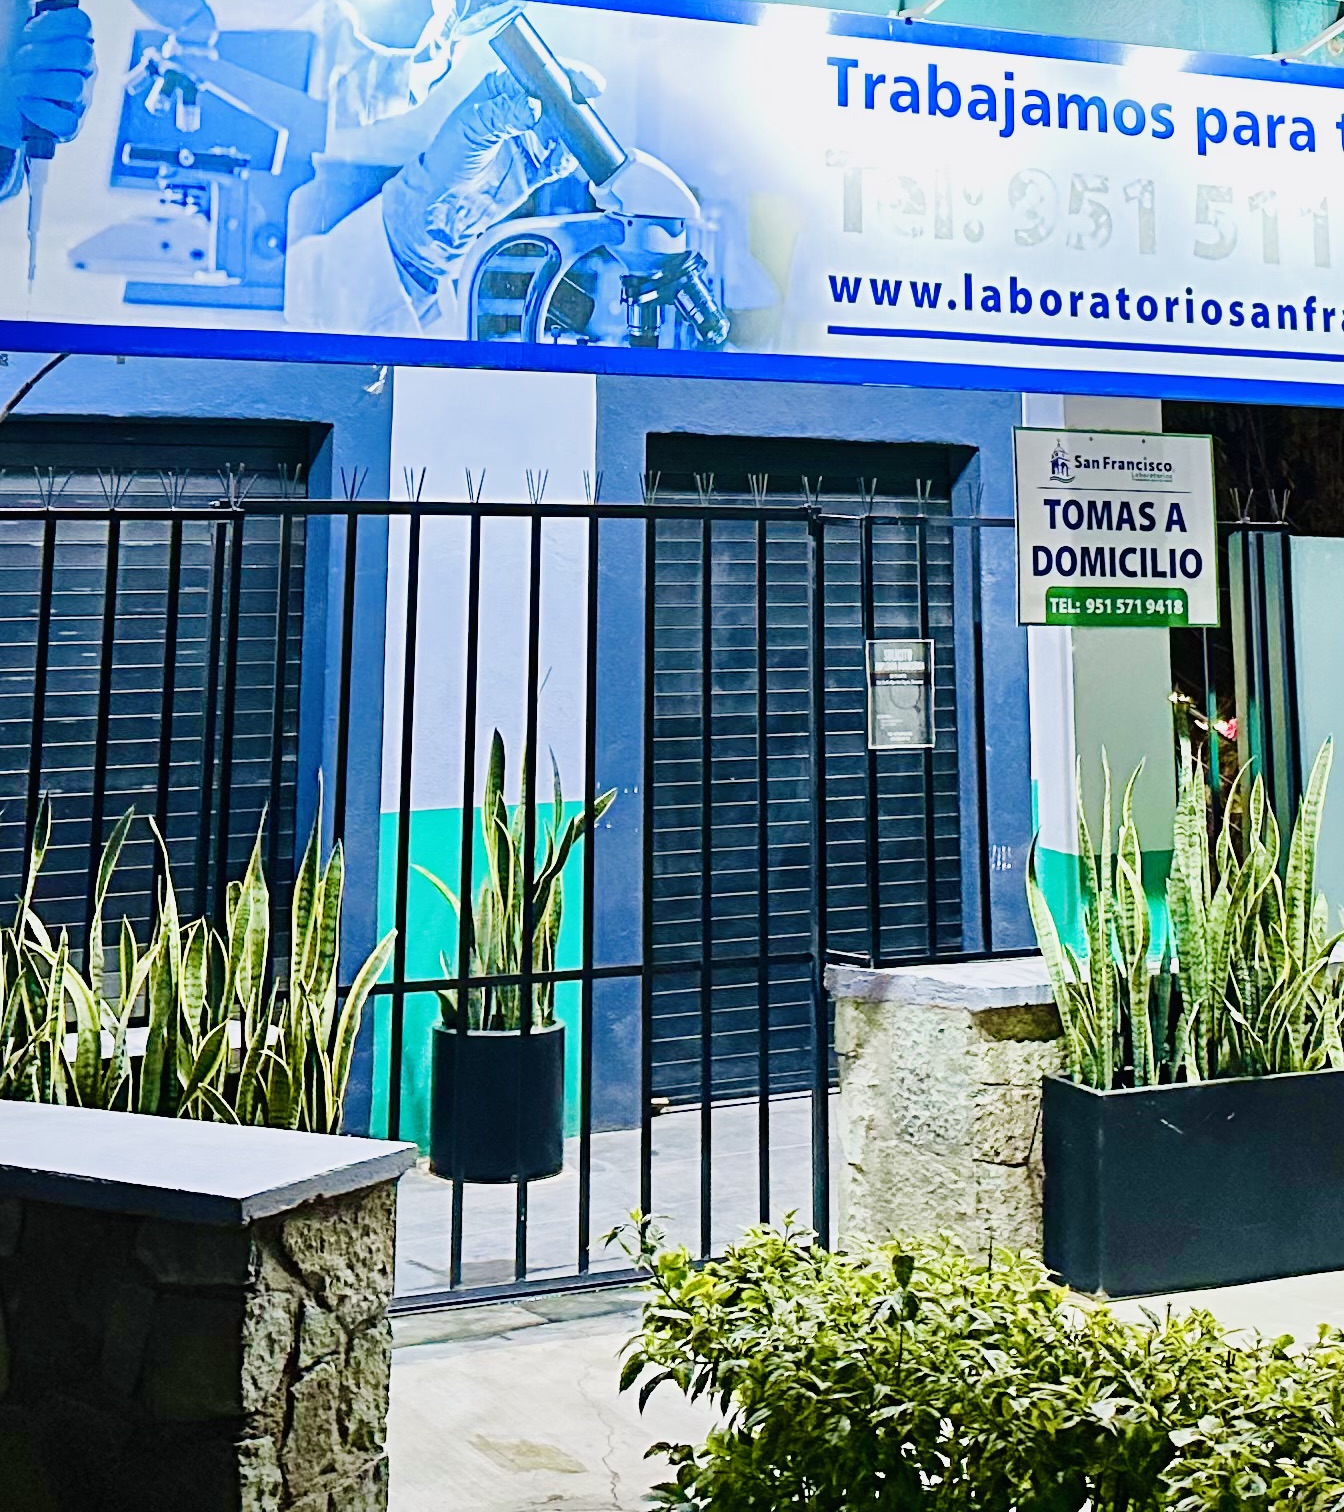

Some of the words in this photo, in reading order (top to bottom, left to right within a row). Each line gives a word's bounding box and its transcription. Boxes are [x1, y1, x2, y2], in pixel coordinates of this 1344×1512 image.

[826, 56, 1175, 140] Trabajamos
[1196, 105, 1317, 155] para
[1009, 167, 1157, 255] 951
[1194, 183, 1331, 268] 511
[1074, 455, 1100, 470] San
[1103, 456, 1173, 473] Francisco
[1043, 498, 1157, 532] TOMAS
[1165, 502, 1188, 533] A
[1032, 545, 1203, 579] DOMICILIO
[1049, 597, 1081, 615] TEL:
[1085, 598, 1112, 615] 951
[1116, 598, 1142, 615] 571
[1146, 599, 1184, 615] 9418
